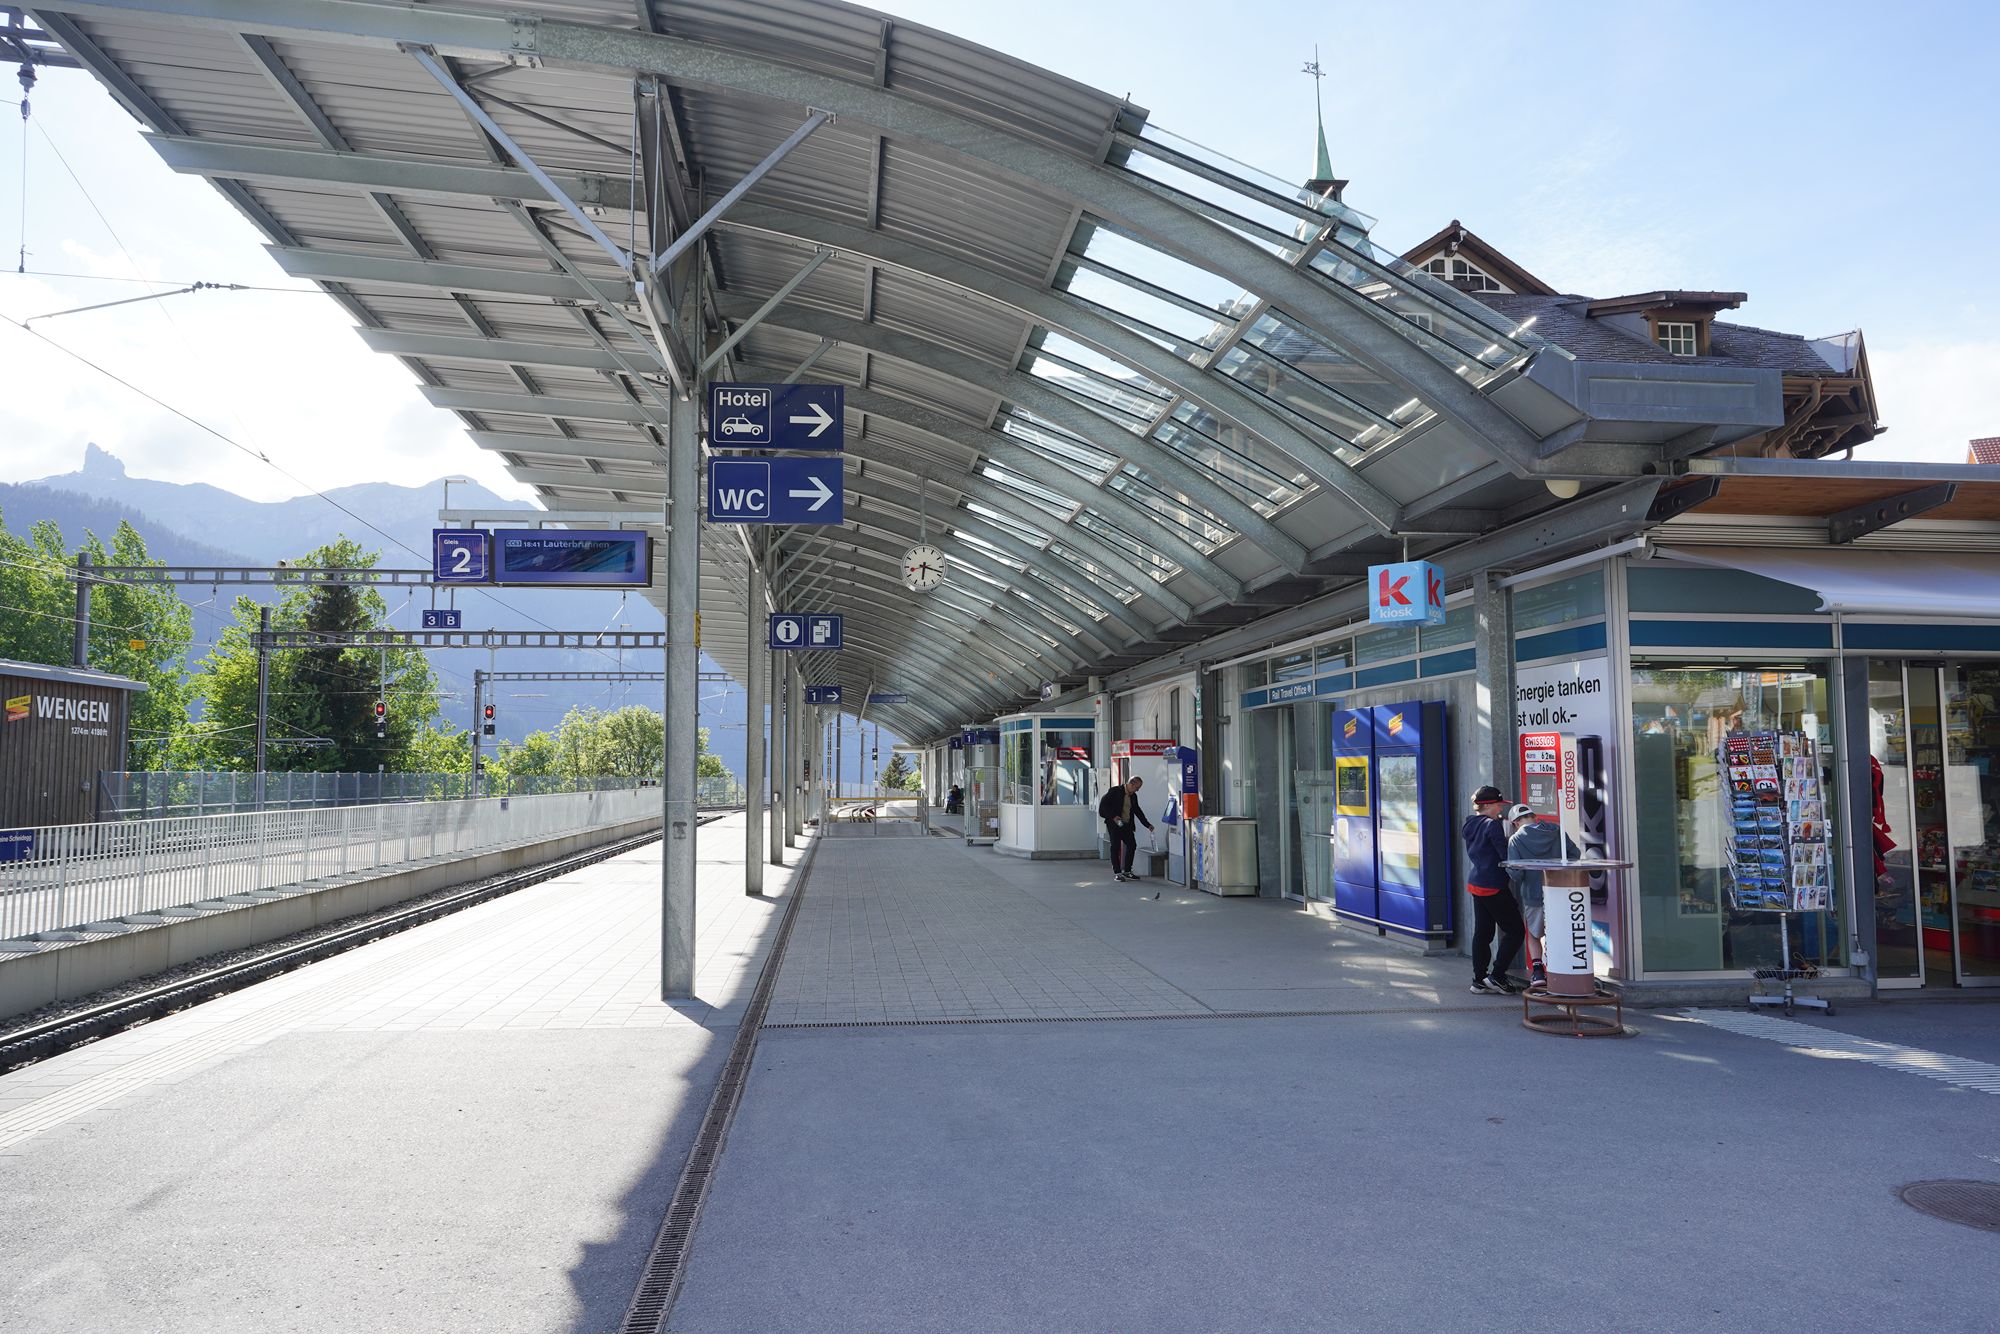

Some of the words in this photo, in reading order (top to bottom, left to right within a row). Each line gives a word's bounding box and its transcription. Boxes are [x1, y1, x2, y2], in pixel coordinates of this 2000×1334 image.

[719, 392, 767, 407] Hotel
[718, 488, 765, 511] WC
[544, 540, 610, 549] Lauterbrunnen
[452, 548, 471, 573] 2
[428, 616, 436, 625] 3
[447, 616, 455, 625] B
[1380, 608, 1413, 618] kiosk
[1272, 690, 1280, 700] Rail
[1280, 688, 1293, 698] Travel
[1294, 684, 1306, 696] Office
[1558, 676, 1601, 696] tanken
[812, 692, 816, 701] 1
[36, 696, 109, 722] WENGEN
[1530, 708, 1549, 726] voll
[1525, 736, 1555, 746] SWISSLOS
[1565, 751, 1575, 810] SWISSLOS
[1568, 891, 1588, 970] LATTESSO
